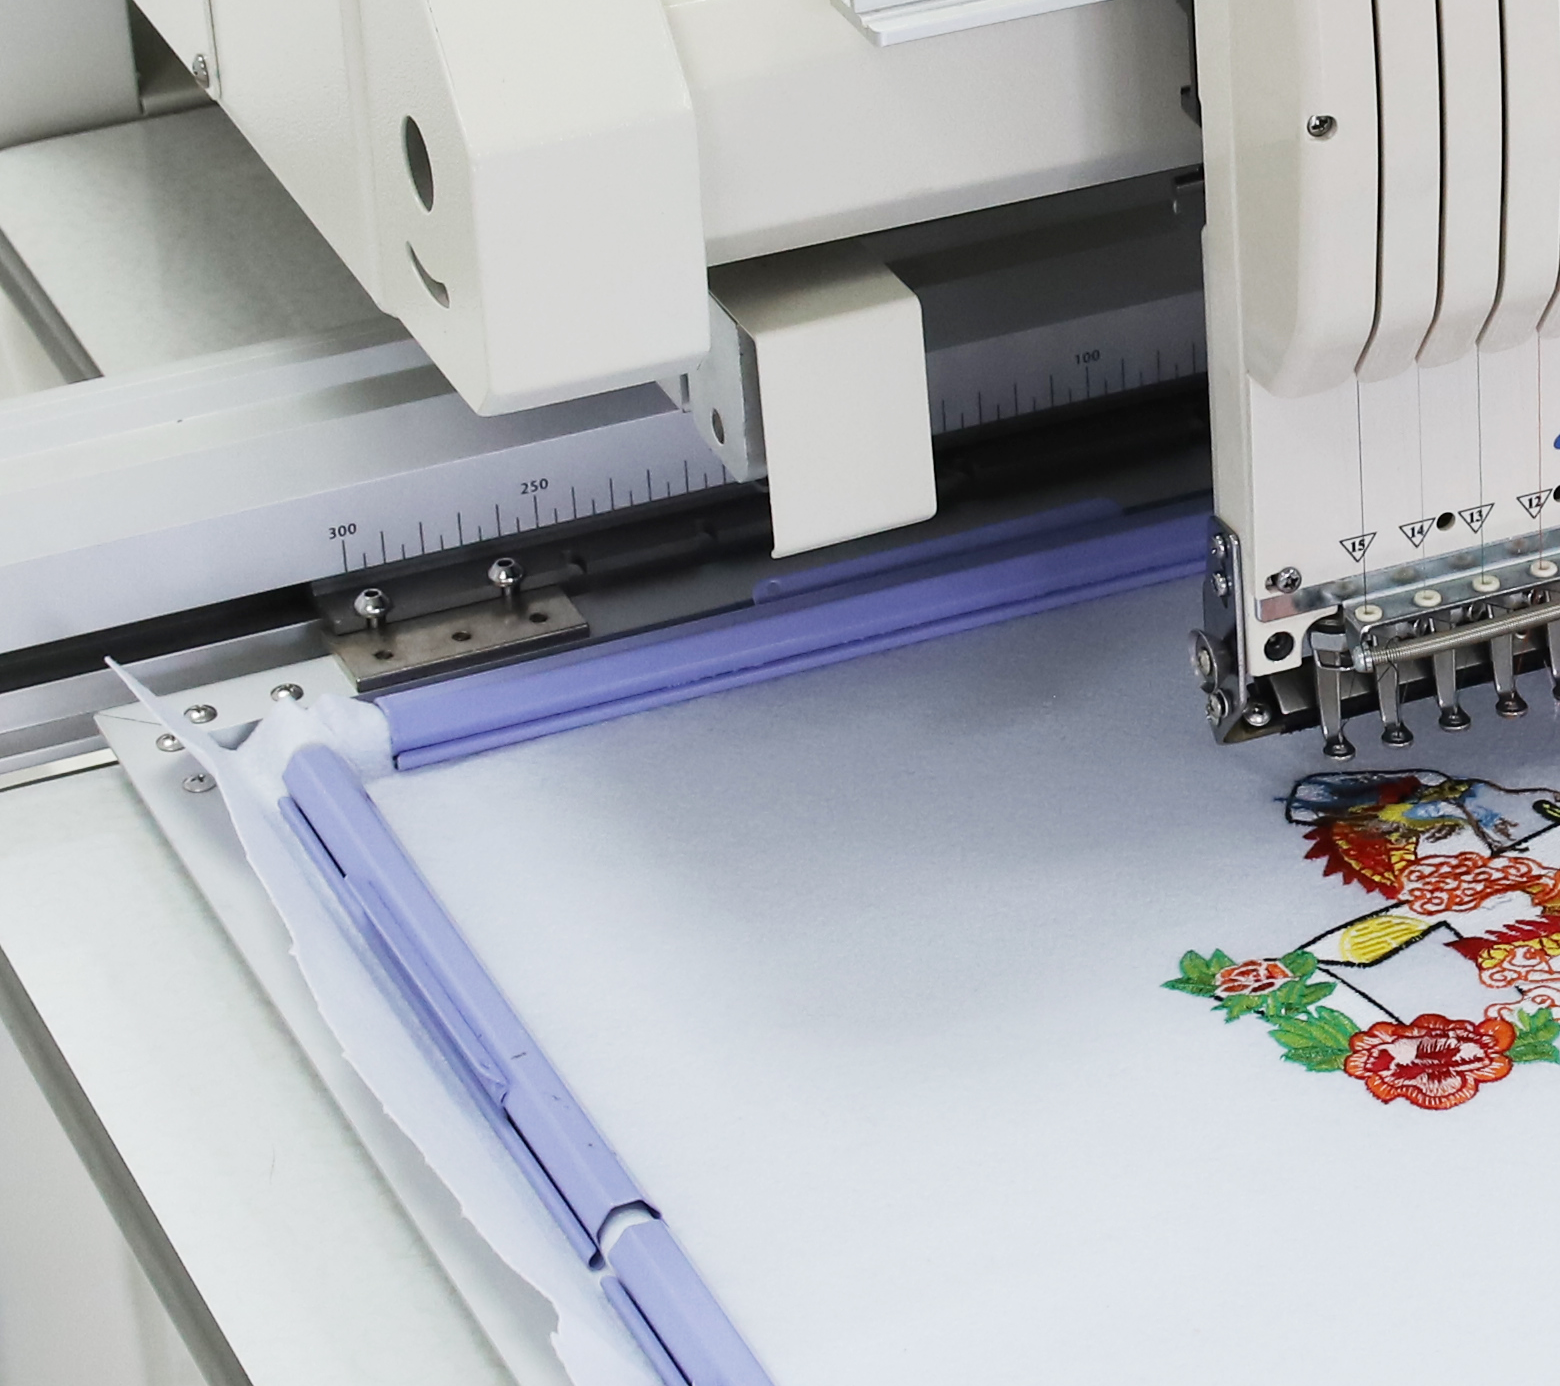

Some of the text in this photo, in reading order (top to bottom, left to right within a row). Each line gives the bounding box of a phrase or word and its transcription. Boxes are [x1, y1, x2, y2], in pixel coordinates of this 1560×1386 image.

[1075, 349, 1100, 365] 100
[328, 477, 549, 540] 300 250
[1350, 538, 1366, 554] 15
[1409, 524, 1425, 539] 14
[1468, 509, 1484, 524] 13
[1526, 495, 1542, 509] 12
